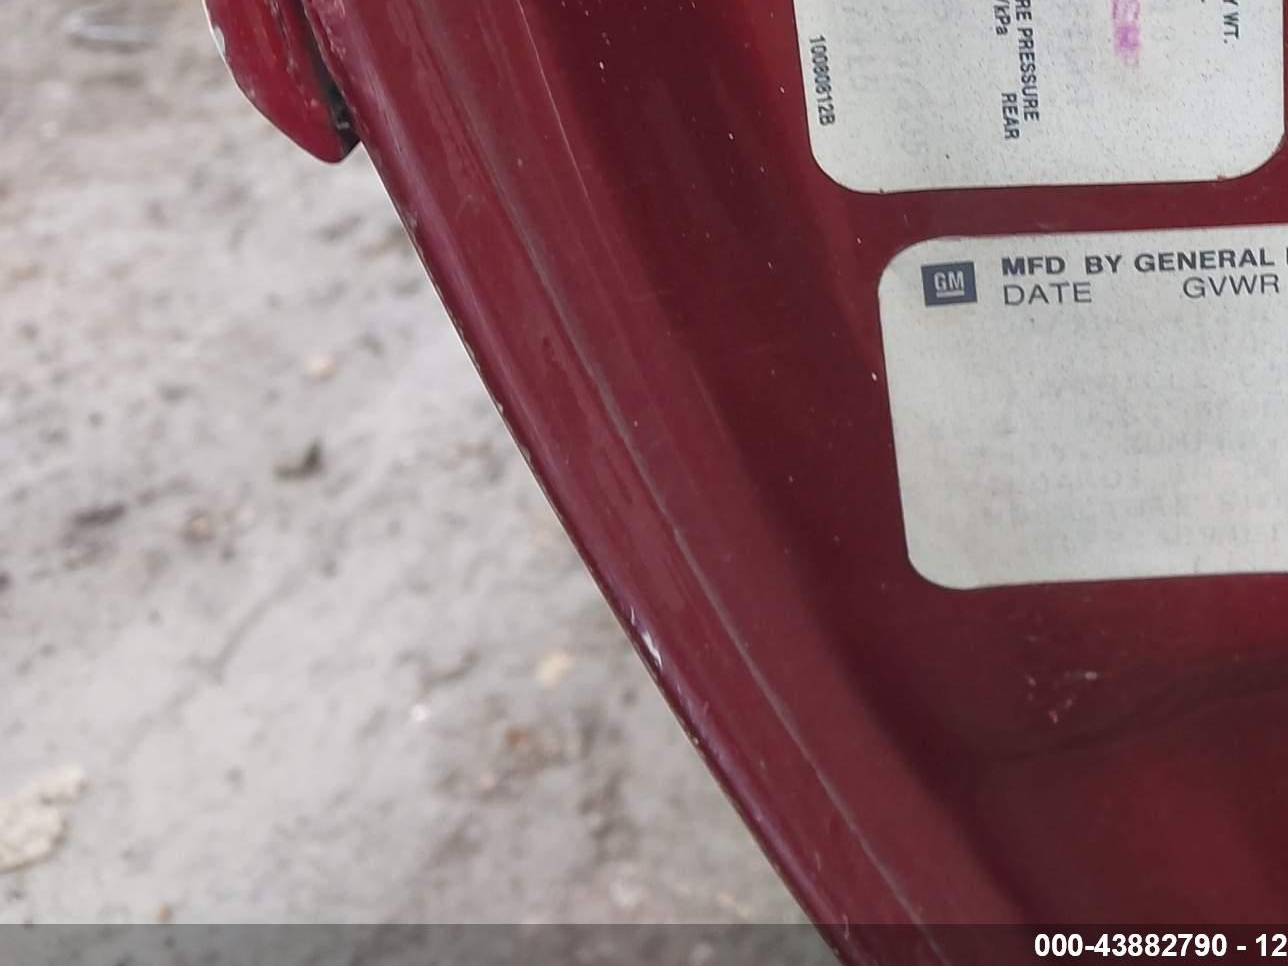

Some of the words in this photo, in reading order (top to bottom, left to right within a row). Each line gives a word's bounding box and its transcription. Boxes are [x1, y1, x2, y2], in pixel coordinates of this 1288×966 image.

[1224, 12, 1239, 43] WT.
[1016, 28, 1039, 122] PRESSURE
[1002, 93, 1019, 139] REAR
[1002, 256, 1065, 276] MFD
[1085, 255, 1122, 274] BY
[1134, 248, 1274, 273] GENERAL
[934, 270, 965, 292] GM
[1004, 282, 1091, 306] DATE
[1183, 274, 1279, 298] GVWR
